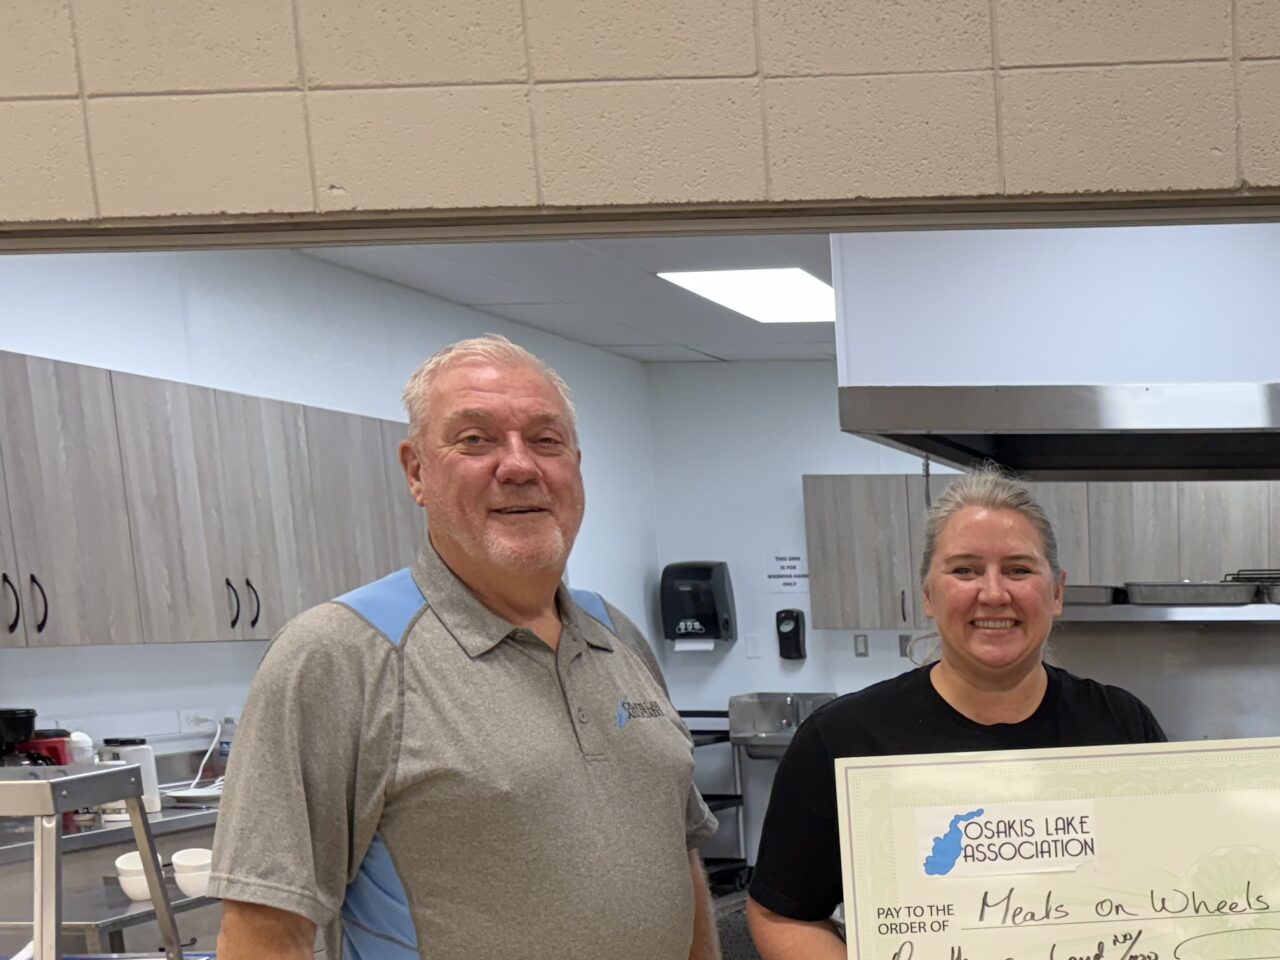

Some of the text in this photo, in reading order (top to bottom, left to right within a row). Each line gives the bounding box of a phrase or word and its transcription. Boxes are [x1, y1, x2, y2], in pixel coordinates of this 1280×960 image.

[963, 815, 1090, 840] OSAKIS LAKE
[963, 837, 1096, 863] ASSOCIATION
[877, 903, 955, 920] PAY TO THE
[979, 887, 1070, 926] Meals
[1151, 880, 1270, 915] Wheels
[877, 919, 950, 935] ORDER OF
